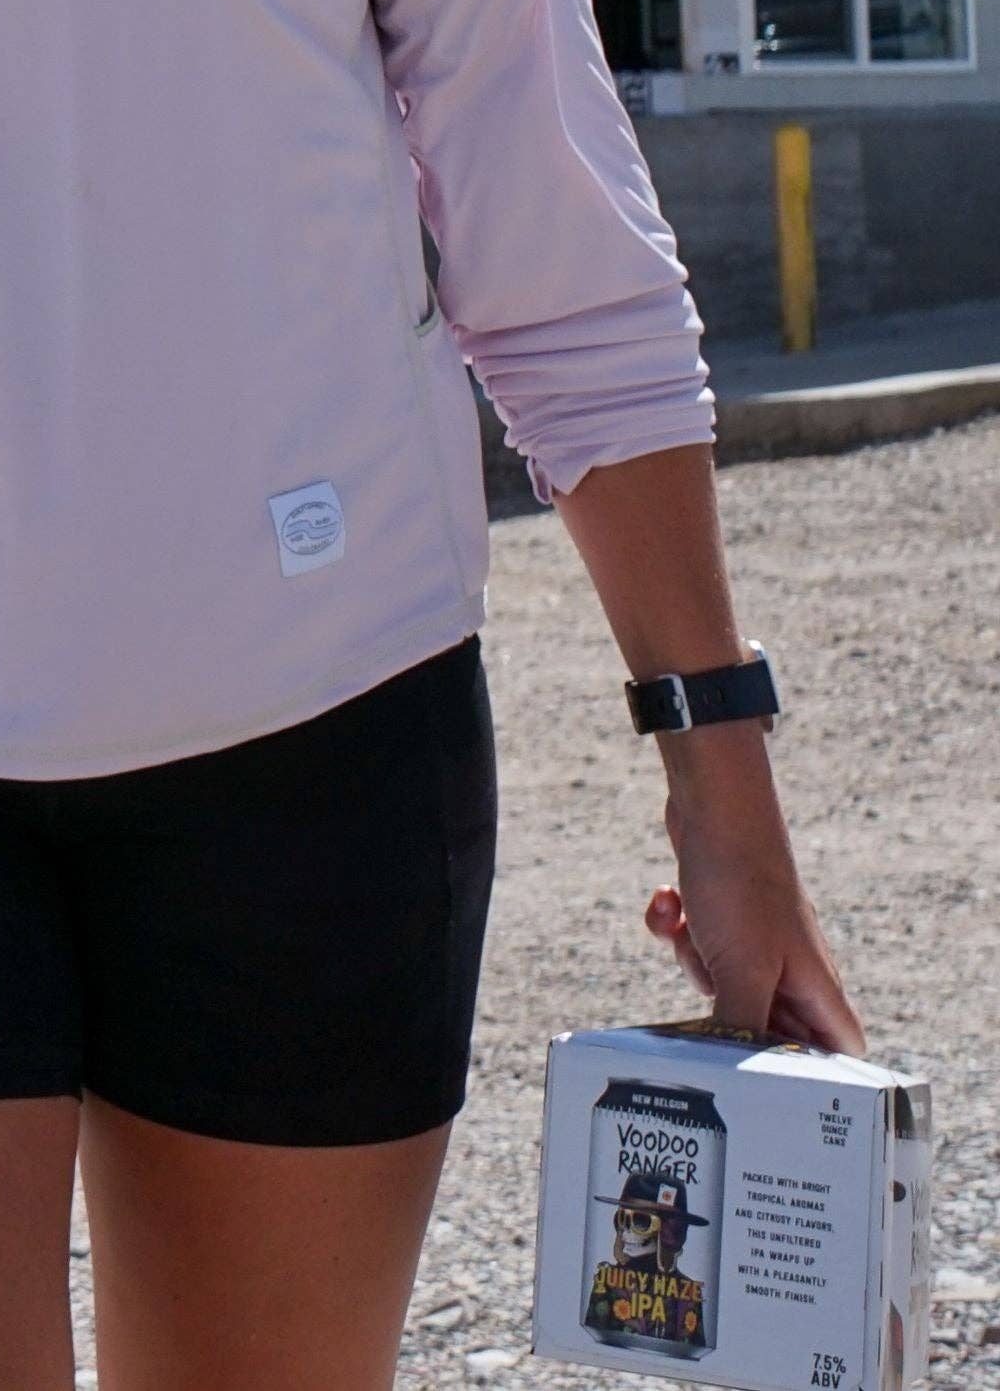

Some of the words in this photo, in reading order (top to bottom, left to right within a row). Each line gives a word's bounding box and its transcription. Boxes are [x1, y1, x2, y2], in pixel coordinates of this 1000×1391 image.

[632, 1093, 652, 1105] NEW
[832, 1097, 840, 1111] 6
[818, 1111, 853, 1126] TWELVE
[617, 1122, 699, 1158] VOODOO
[821, 1123, 849, 1137] OUNCE
[823, 1135, 846, 1147] CANS
[617, 1149, 699, 1185] RANGER
[742, 1171, 774, 1185] PACKED
[777, 1177, 799, 1189] WITH
[802, 1181, 832, 1194] BRIGHT
[747, 1190, 786, 1206] TROPICAL
[790, 1197, 825, 1212] AROMAS
[735, 1207, 753, 1219] AND
[756, 1211, 791, 1225] CITRUSY
[747, 1227, 766, 1240] THIS
[770, 1232, 821, 1249] UNFILTERED
[750, 1247, 765, 1258] IPA
[769, 1249, 800, 1265] WRAPS
[803, 1256, 815, 1266] UP
[594, 1263, 649, 1294] JUICY
[653, 1273, 704, 1302] HAZE
[737, 1264, 760, 1276] WITH
[763, 1268, 770, 1278] A
[772, 1269, 827, 1288] PLEASANTLY
[745, 1283, 781, 1298] SMOOTH
[630, 1292, 666, 1323] IPA
[813, 1352, 847, 1374] 7.5%
[811, 1370, 841, 1390] ABV
